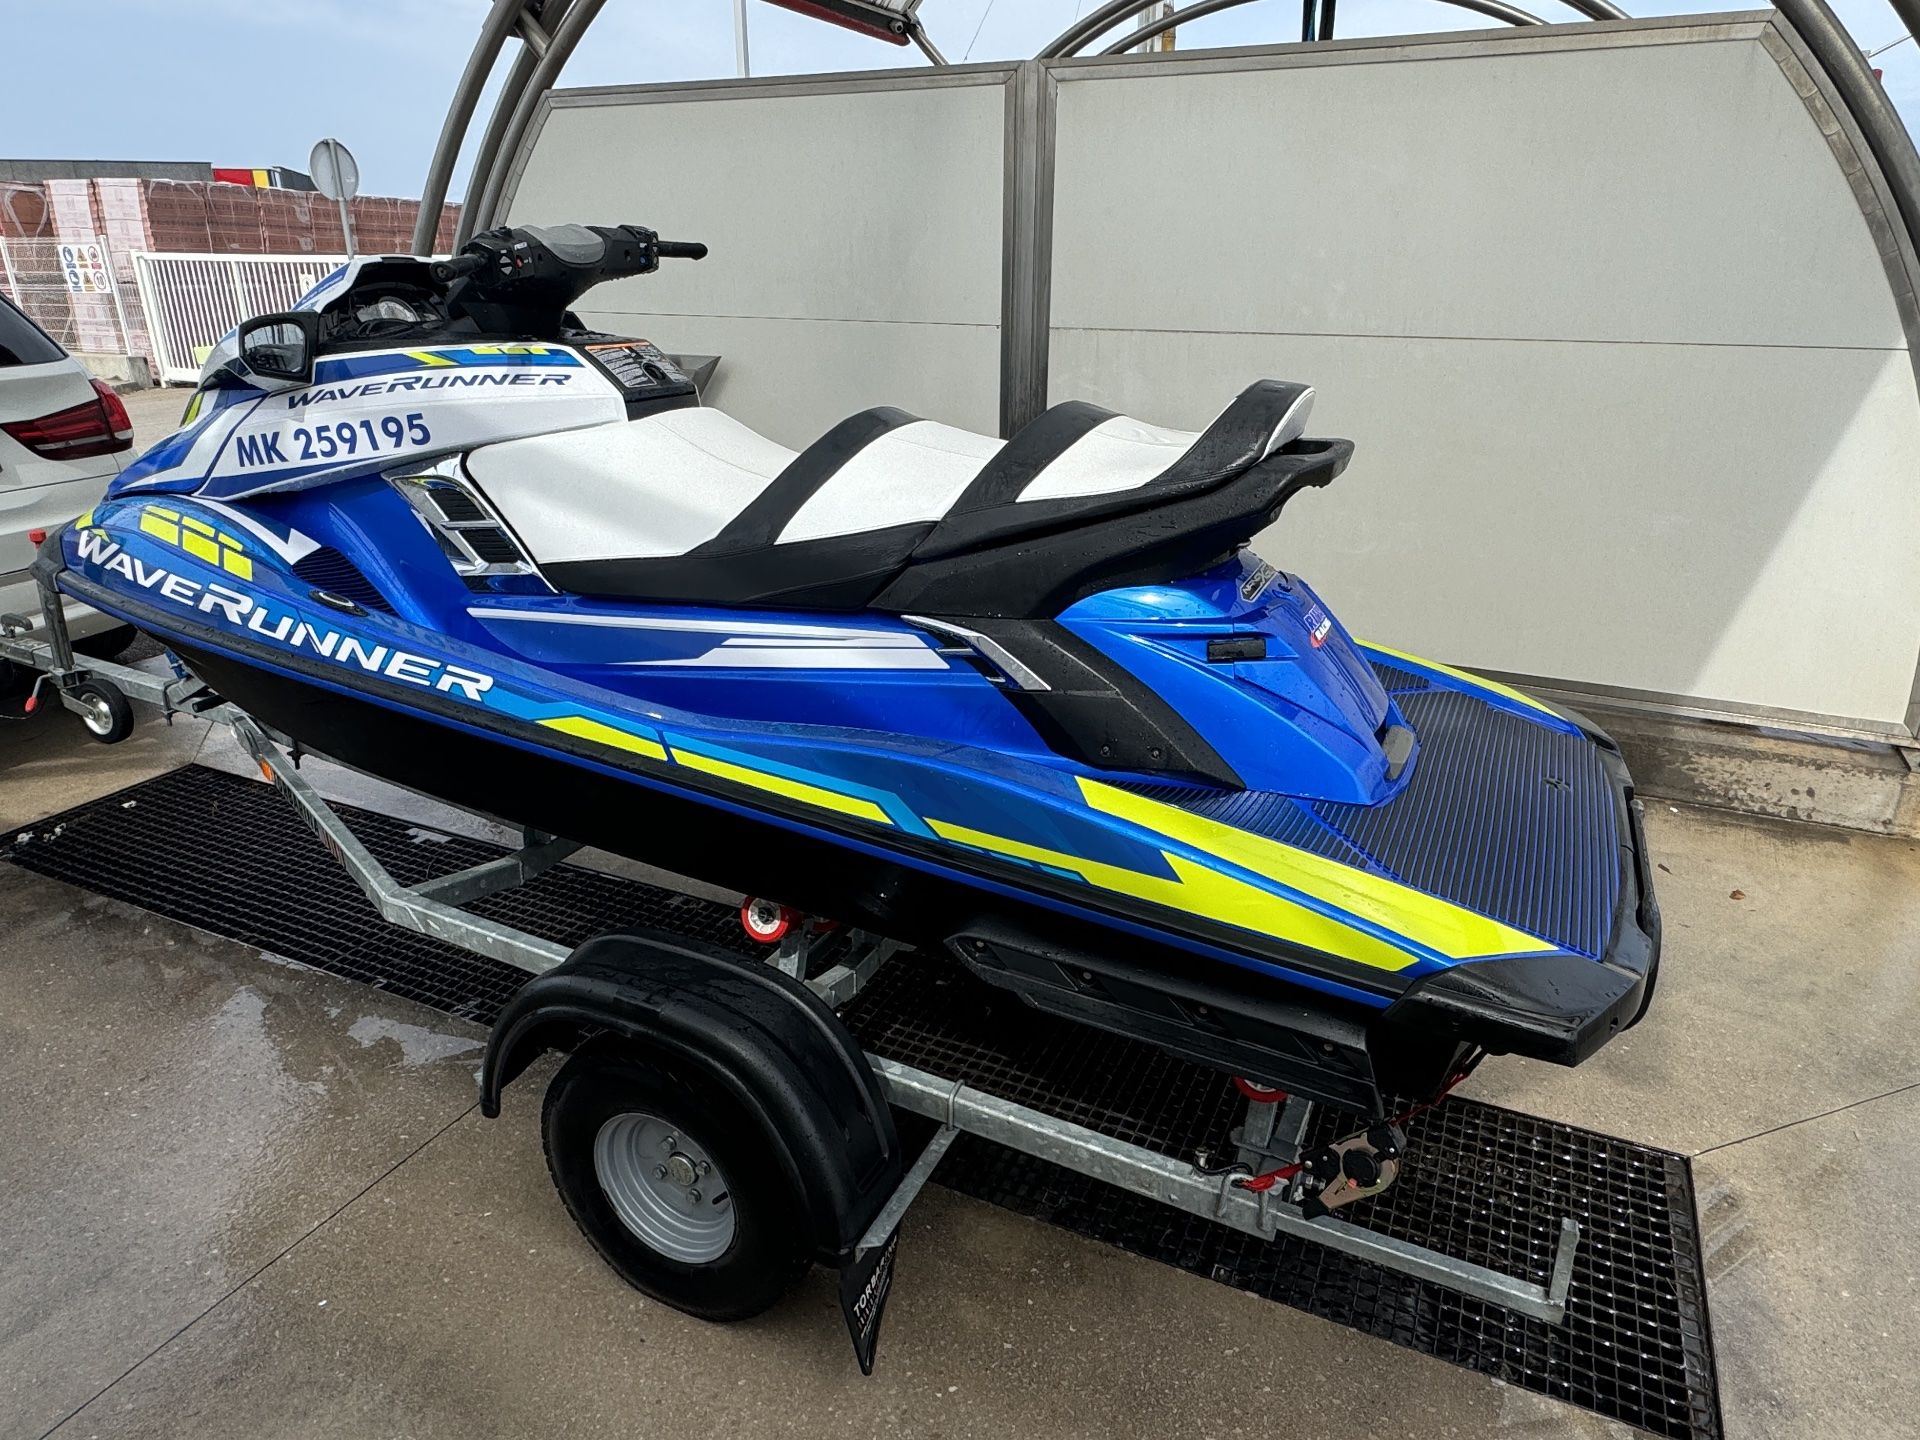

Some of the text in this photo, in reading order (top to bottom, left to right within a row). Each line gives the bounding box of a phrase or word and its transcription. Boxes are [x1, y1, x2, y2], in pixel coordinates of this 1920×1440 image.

[288, 373, 572, 410] WAVERUNNER
[236, 412, 432, 468] MK 259195
[77, 530, 494, 702] WAVERUNNER
